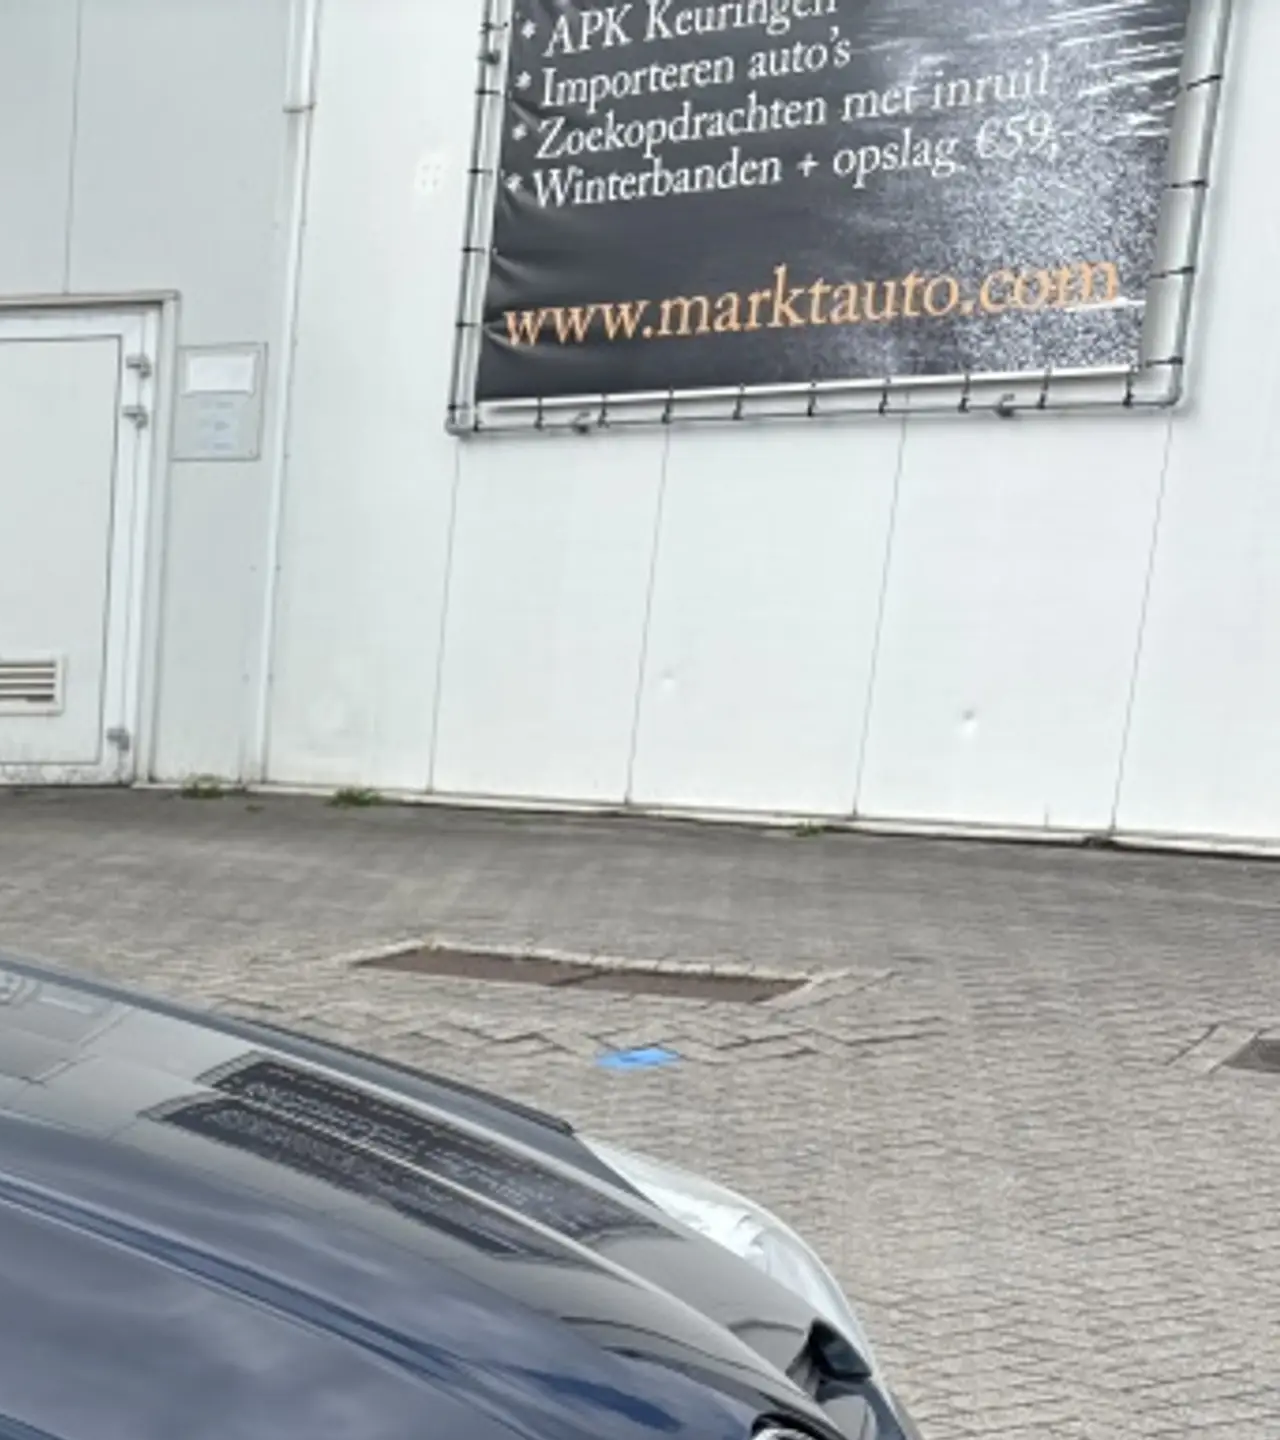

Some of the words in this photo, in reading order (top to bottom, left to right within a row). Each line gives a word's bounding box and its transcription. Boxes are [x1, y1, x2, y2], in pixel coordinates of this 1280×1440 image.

[541, 53, 735, 116] Importeren
[747, 26, 851, 80] auto's
[542, 3, 633, 58] APK
[534, 89, 827, 160] Zoekopdrachten
[841, 85, 919, 123] met
[929, 49, 1048, 111] inruil
[532, 146, 782, 209] Winterbanden
[832, 126, 960, 190] opslag
[503, 260, 1119, 346] www.marktauto.com
